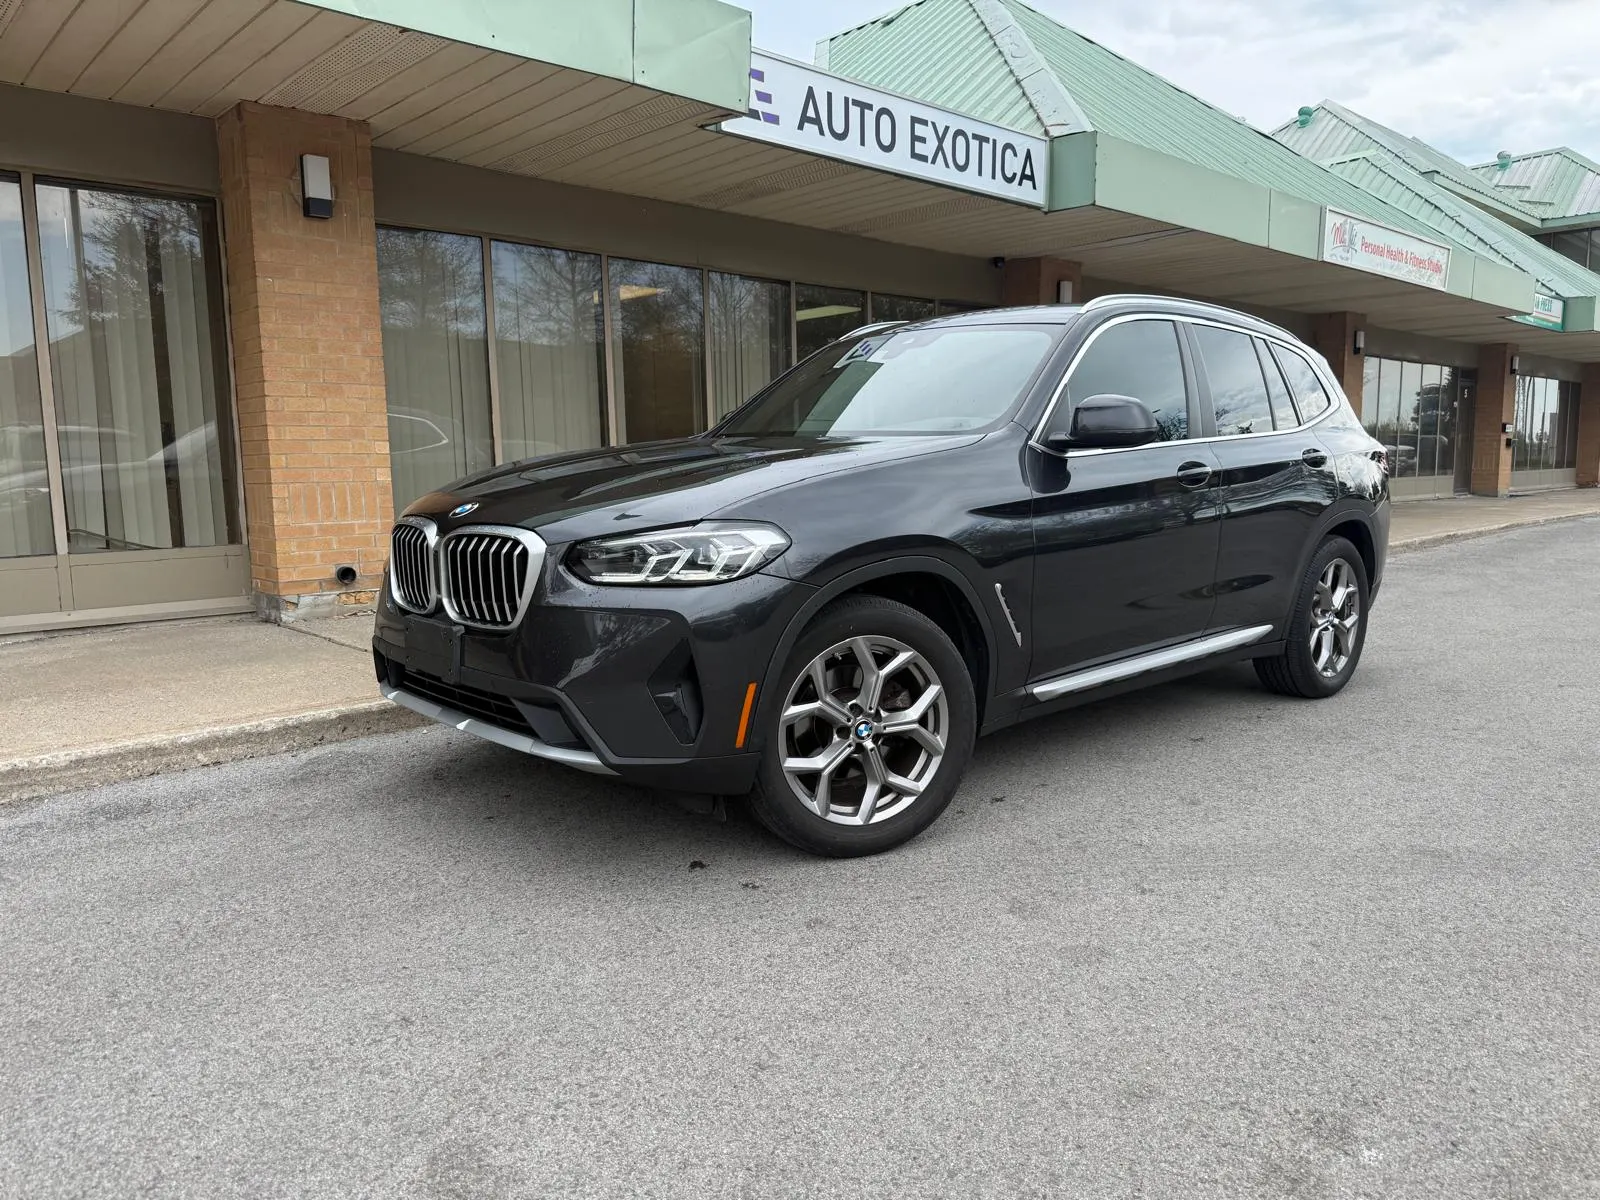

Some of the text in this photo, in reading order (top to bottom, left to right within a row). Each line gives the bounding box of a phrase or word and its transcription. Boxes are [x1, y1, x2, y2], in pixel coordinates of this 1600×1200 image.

[797, 86, 1037, 190] AUTO EXOTICA
[1360, 235, 1386, 258] Personal
[1386, 244, 1405, 263] Health
[1409, 251, 1427, 269] Fitness
[1427, 256, 1443, 274] Studio
